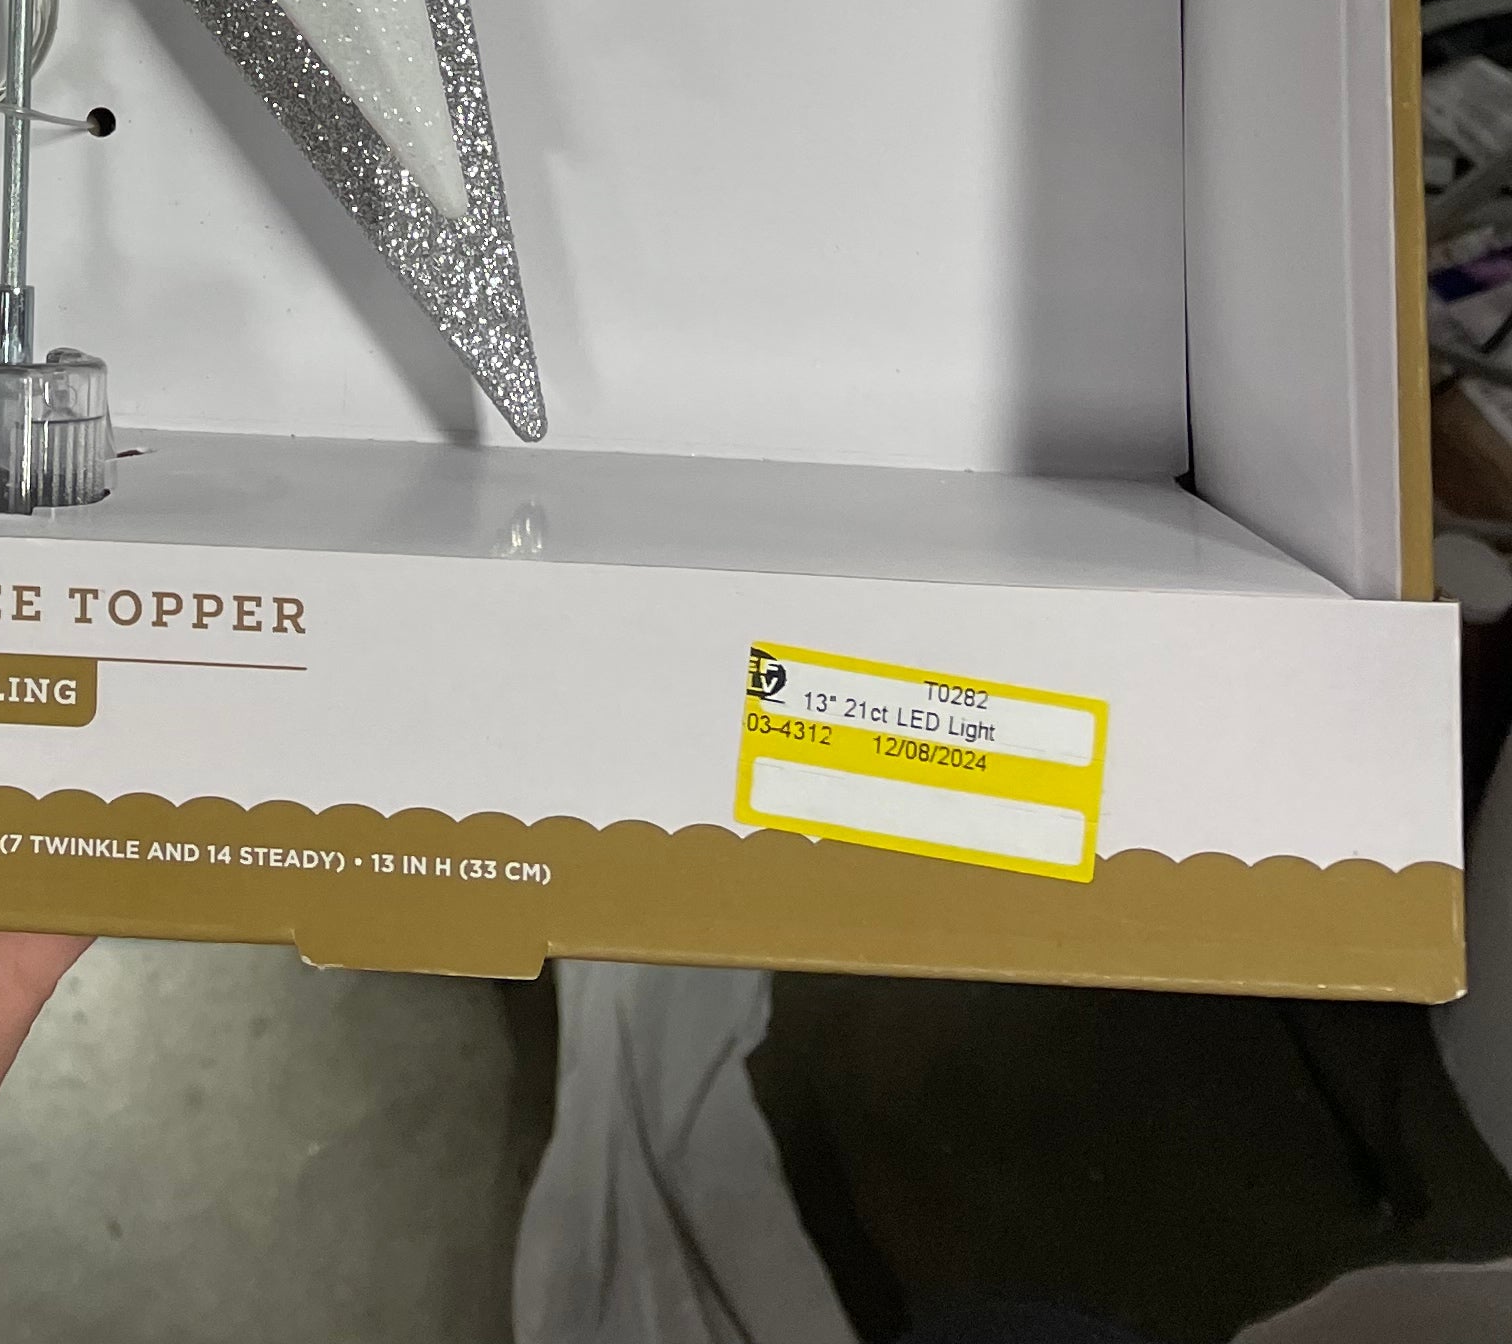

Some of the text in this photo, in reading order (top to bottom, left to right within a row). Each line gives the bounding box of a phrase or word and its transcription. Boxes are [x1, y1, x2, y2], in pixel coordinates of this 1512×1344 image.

[68, 587, 306, 635] TOPPER
[804, 691, 996, 743] 13" 21ct LED Light
[924, 680, 989, 710] T0282
[746, 712, 987, 772] 03-4312 12/08/2024
[0, 834, 23, 855] (7
[29, 835, 140, 859] TWINKLE
[146, 841, 200, 862] AND
[207, 845, 232, 864] 14
[239, 846, 345, 873] STEADY)
[371, 853, 395, 873] 13
[403, 855, 427, 875] IN
[435, 857, 451, 877] H
[459, 859, 497, 881] (33
[504, 861, 551, 886] CM)
